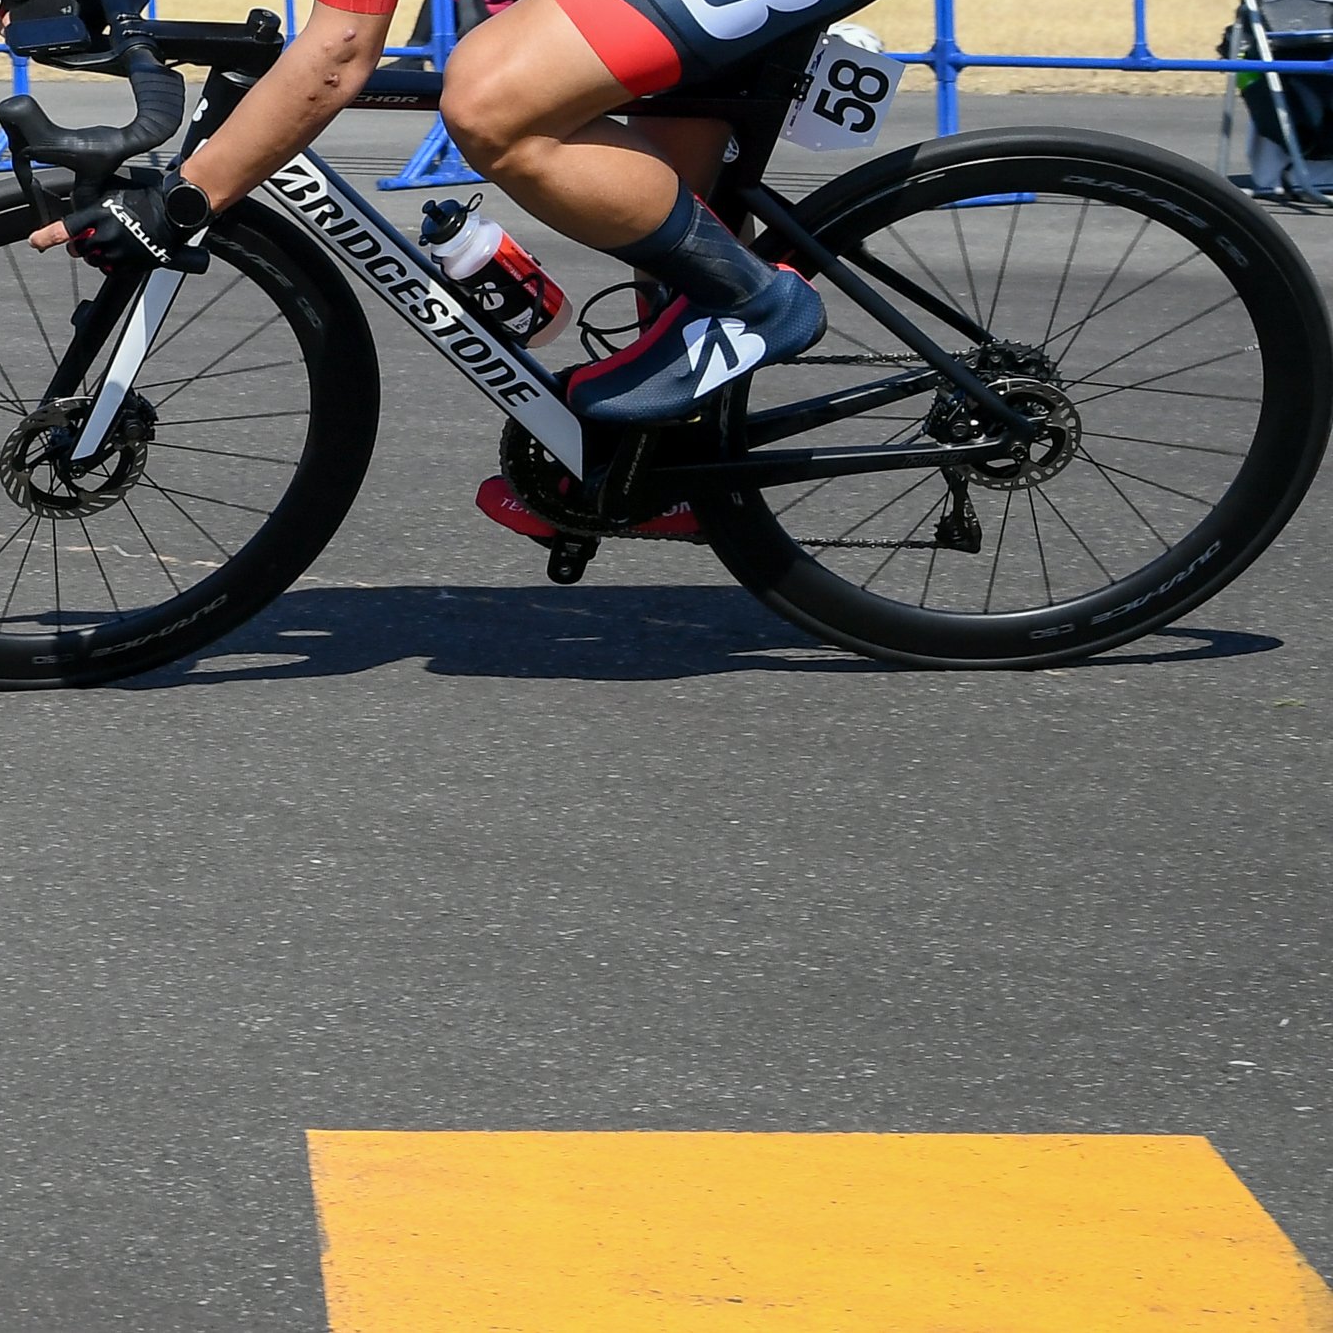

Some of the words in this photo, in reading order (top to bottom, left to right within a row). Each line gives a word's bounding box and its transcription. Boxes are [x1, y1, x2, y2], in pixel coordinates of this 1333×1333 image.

[353, 95, 420, 104] CHOR
[812, 58, 890, 134] 58
[270, 164, 541, 408] BRIDGESTONE
